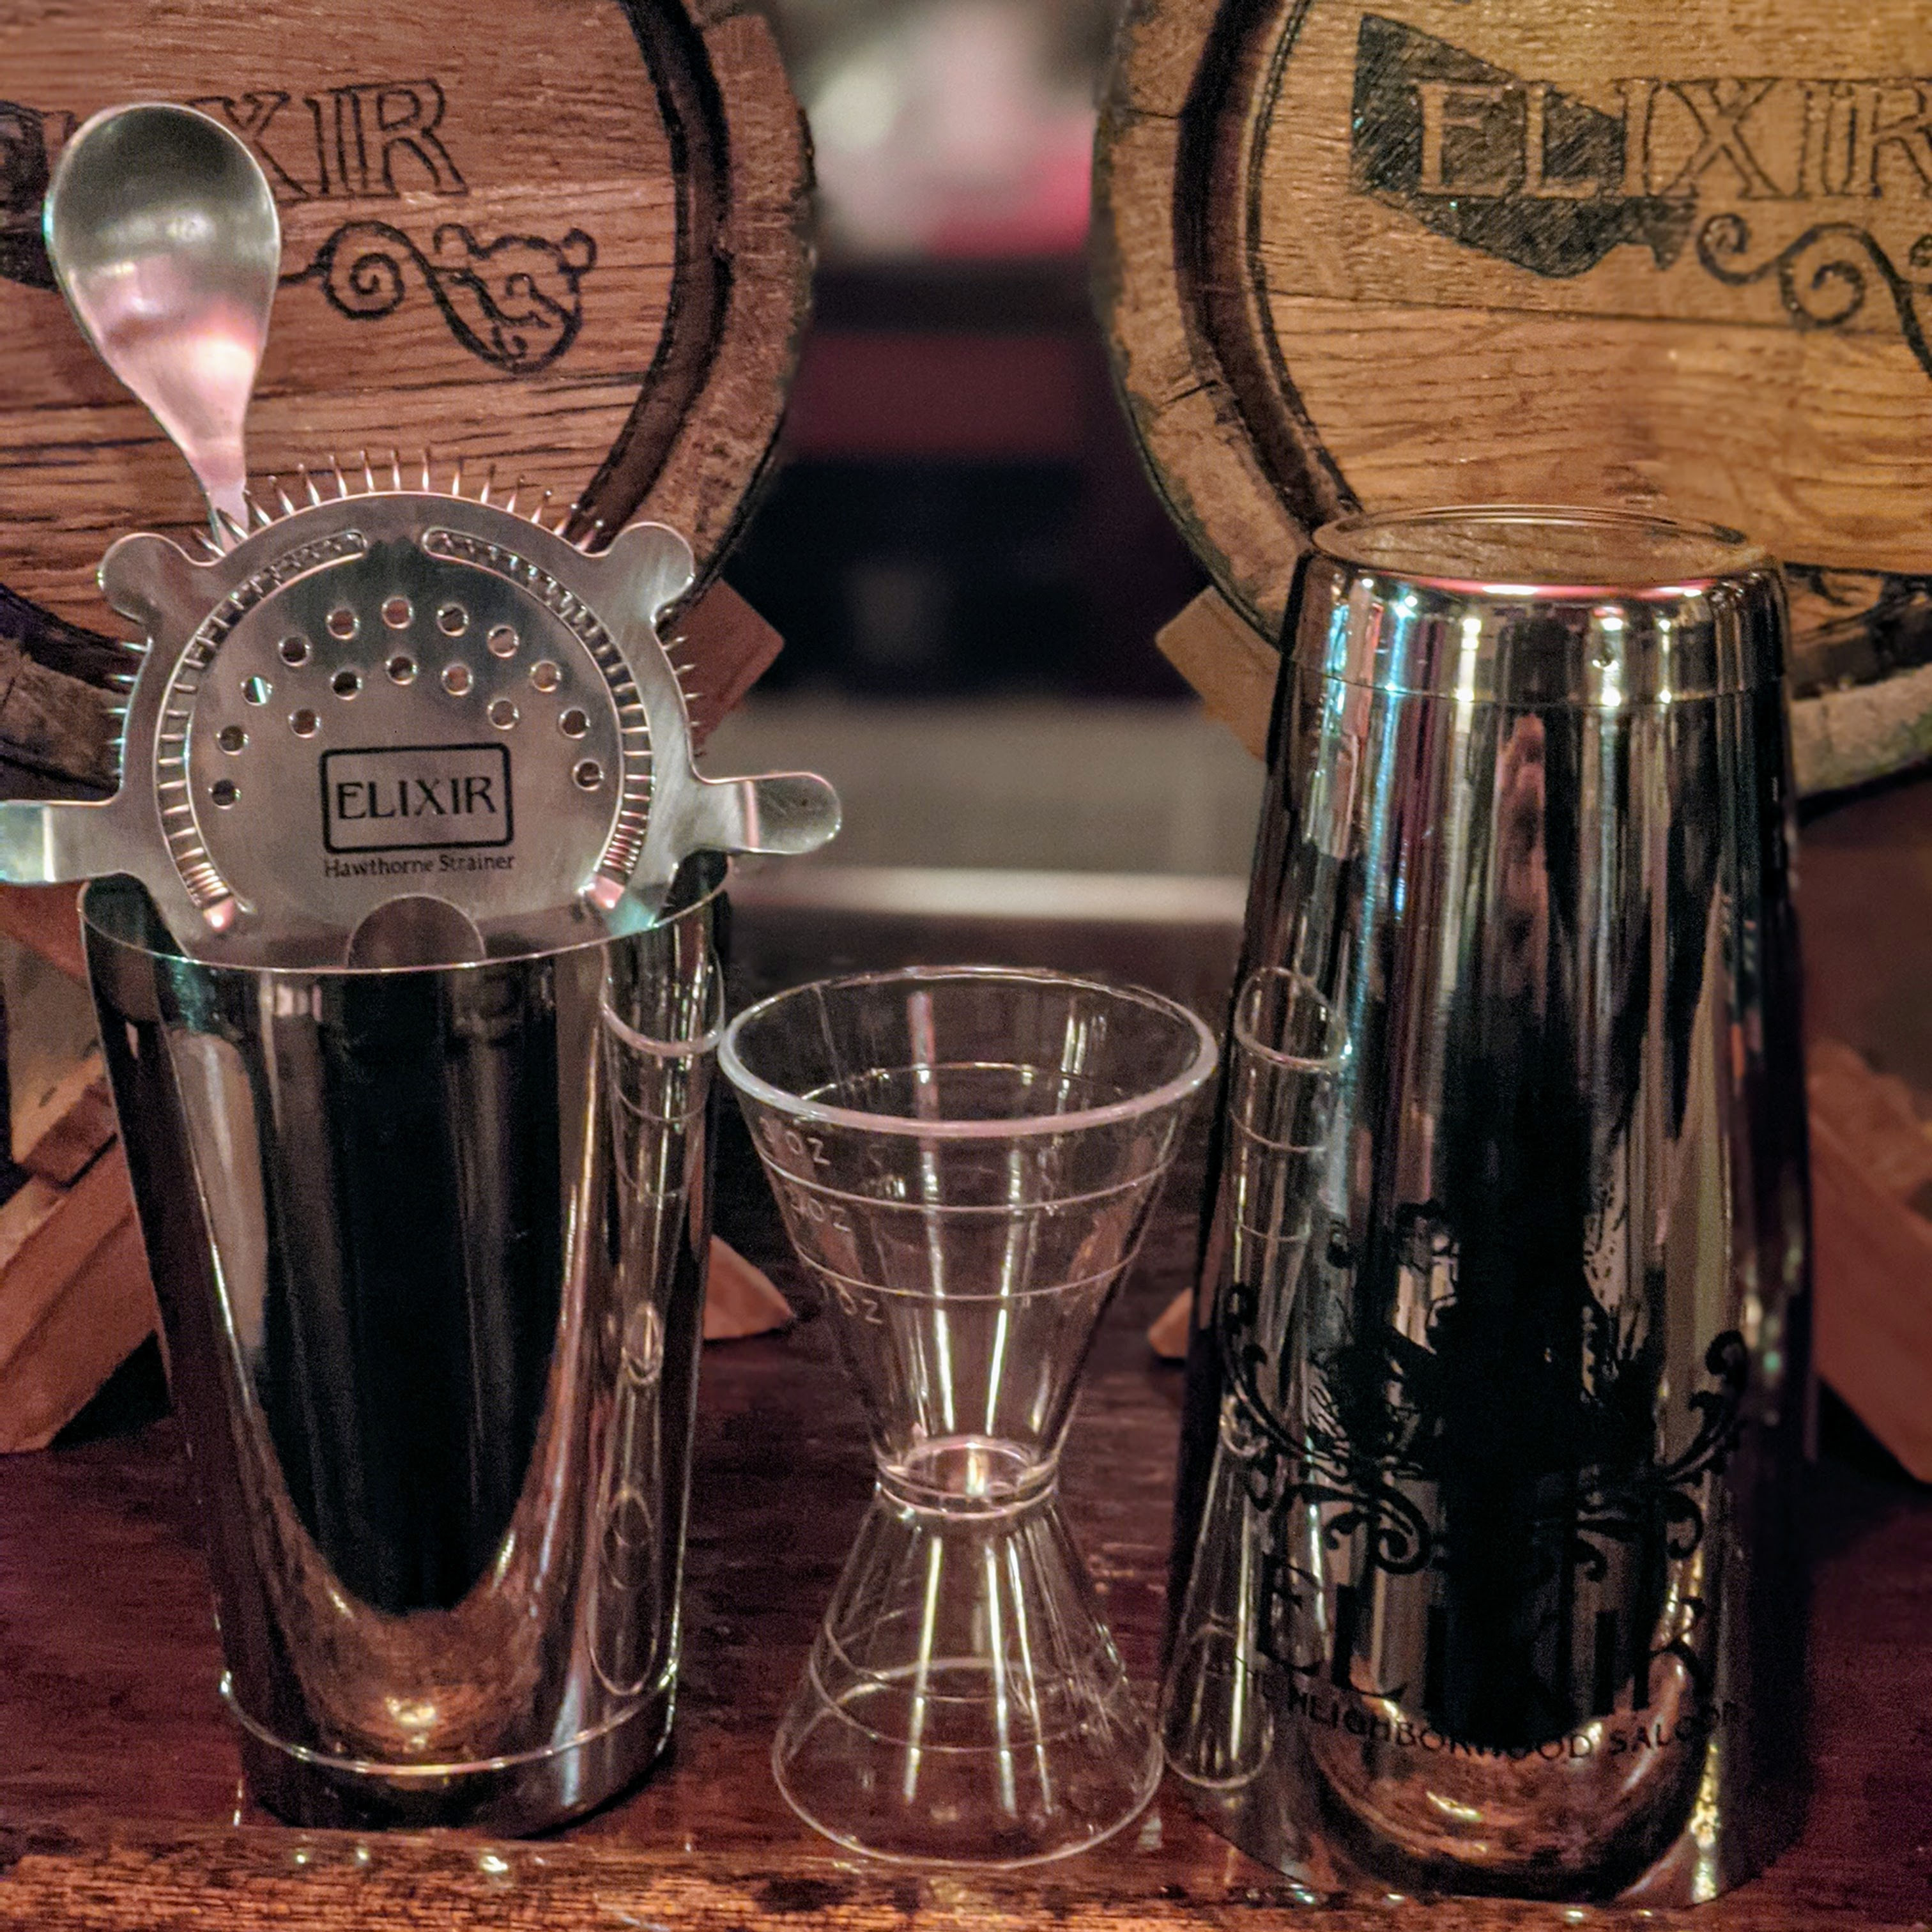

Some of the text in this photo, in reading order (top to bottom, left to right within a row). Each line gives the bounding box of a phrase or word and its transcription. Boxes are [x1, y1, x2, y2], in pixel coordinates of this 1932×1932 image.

[0, 78, 469, 208] XIR
[1409, 75, 1932, 200] ELIXIR
[336, 776, 497, 820] ELIXIR
[324, 854, 515, 878] Hawthorne Strainer
[1287, 1689, 1593, 1761] NEIGHBOROD
